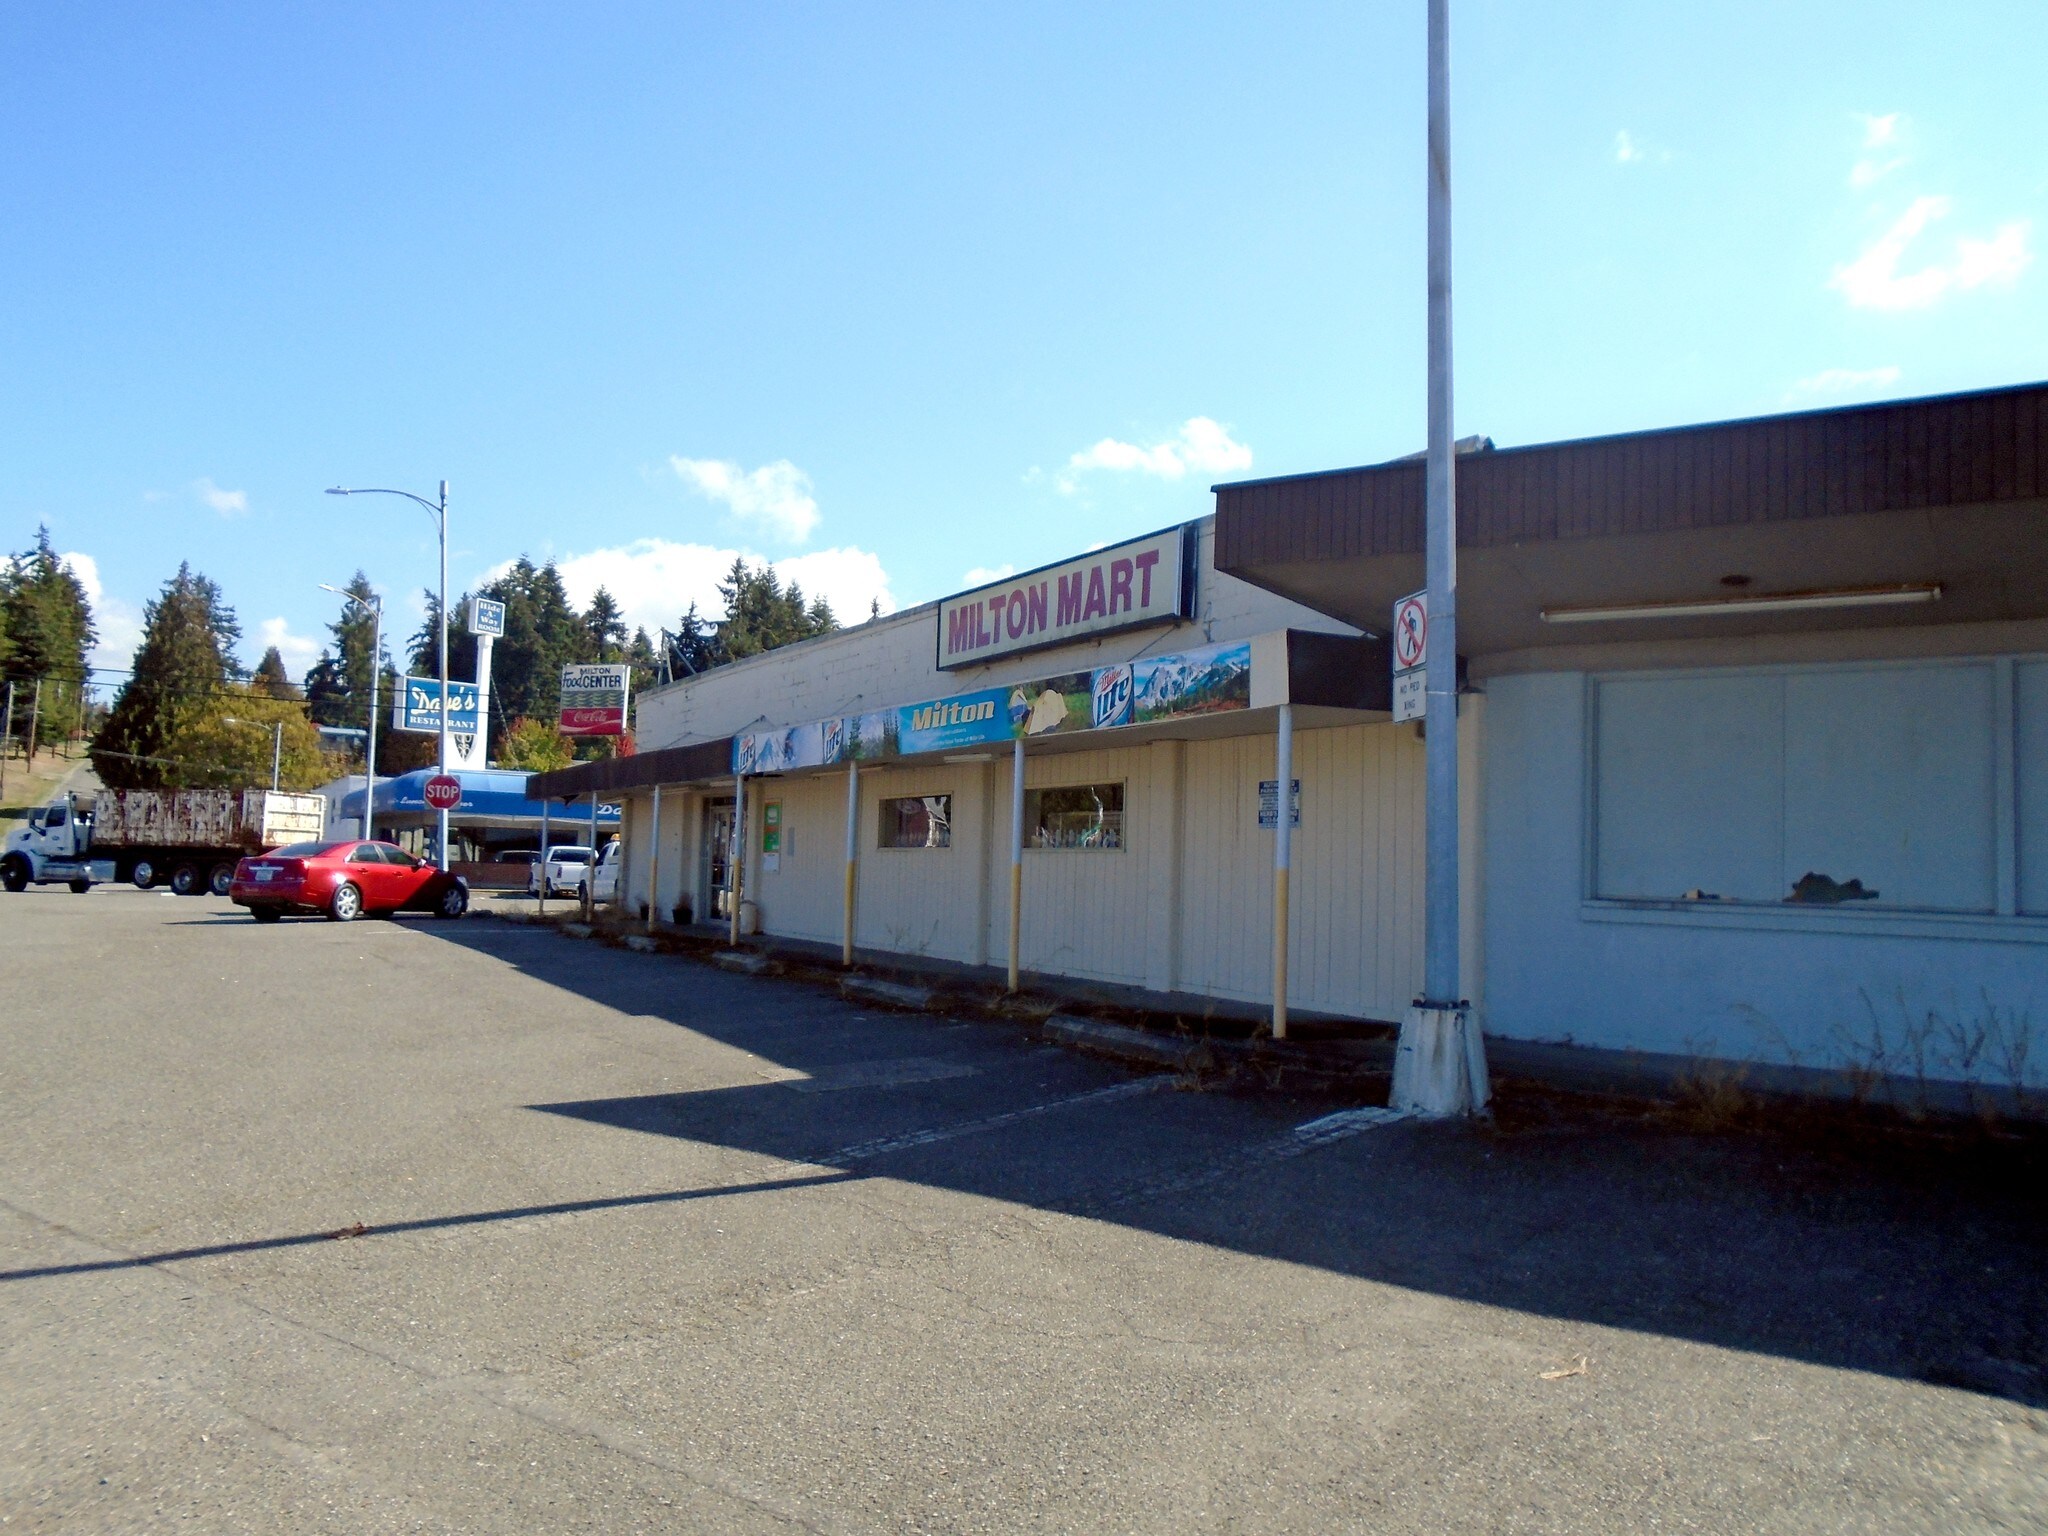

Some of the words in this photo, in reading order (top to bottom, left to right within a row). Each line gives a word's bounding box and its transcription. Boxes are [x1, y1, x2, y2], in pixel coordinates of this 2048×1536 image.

[947, 581, 1048, 655] MILTON
[1056, 549, 1159, 628] MART
[478, 623, 500, 633] ROOM
[480, 615, 498, 627] Way
[580, 667, 610, 675] MILTON
[562, 671, 584, 688] Food
[583, 675, 621, 688] CENTER
[410, 715, 475, 729] RESTARANT
[912, 700, 995, 732] Milton
[427, 784, 459, 799] STOP
